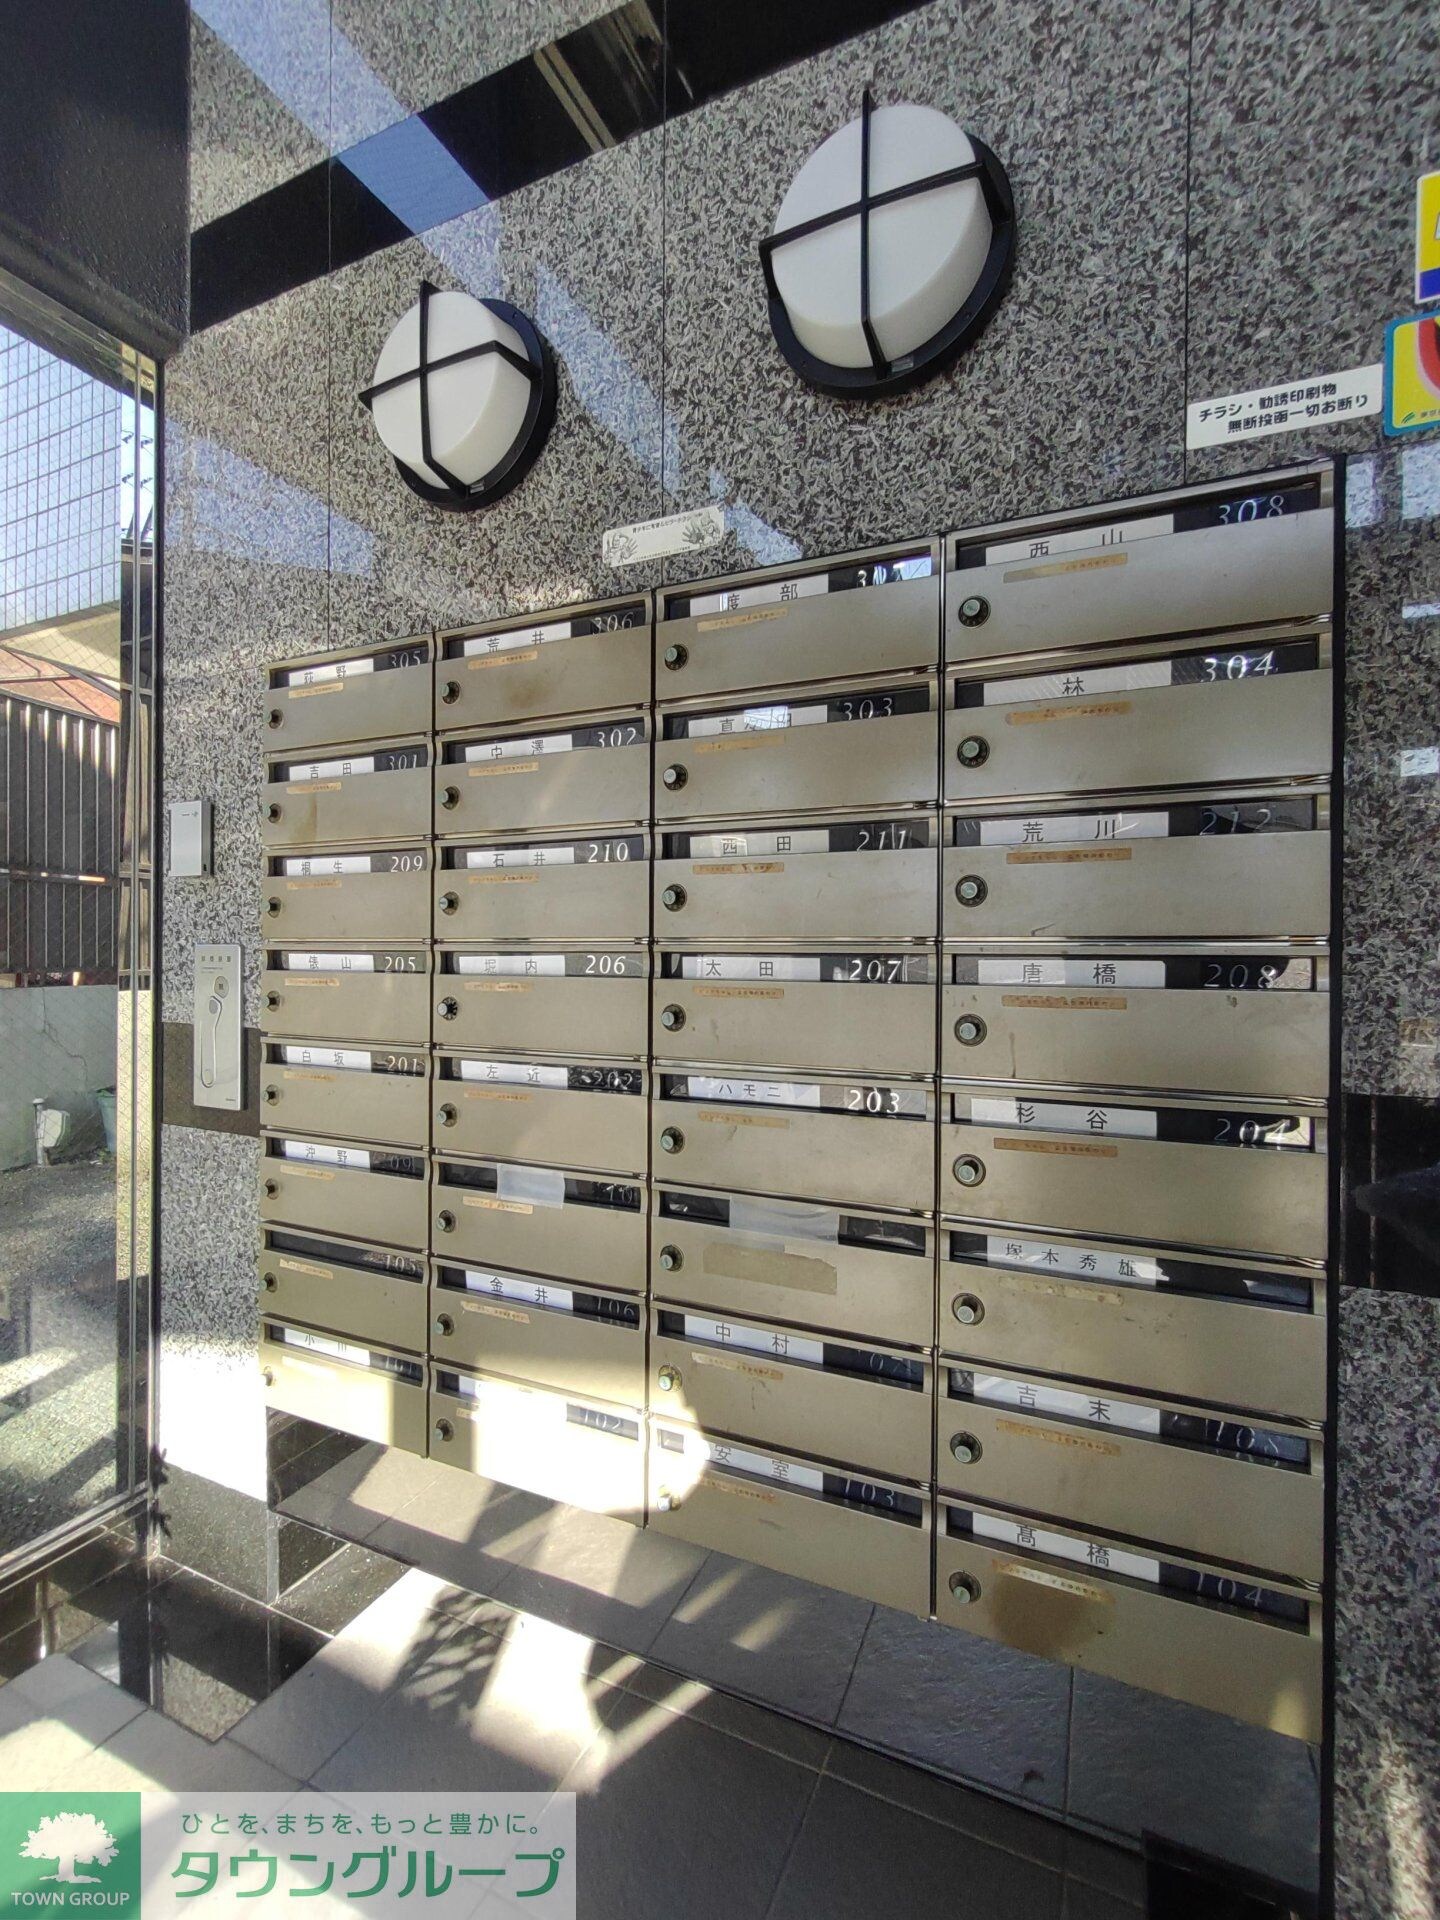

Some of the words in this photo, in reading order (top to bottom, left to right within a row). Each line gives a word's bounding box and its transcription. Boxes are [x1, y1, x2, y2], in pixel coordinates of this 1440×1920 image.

[1199, 383, 1337, 422] チラシ・勧誘印刷物
[1227, 394, 1368, 434] 無断投函一切お断り
[1218, 495, 1284, 525] 308
[592, 611, 633, 634] 306
[486, 630, 545, 653] 荒井
[391, 650, 421, 668] 305
[1201, 650, 1275, 683] 304
[1062, 677, 1085, 696] 林
[842, 698, 892, 720] 303
[597, 727, 637, 748] 302
[309, 762, 352, 779] 吉田
[388, 754, 418, 771] 301
[1022, 819, 1116, 843] 荒川
[1200, 809, 1272, 836] 212
[588, 842, 629, 863] 210
[721, 836, 791, 855] 西田
[390, 855, 424, 873] 209
[492, 851, 547, 868] 石井
[384, 955, 416, 972] 205
[485, 958, 538, 975] 堀内
[585, 955, 626, 974] 206
[706, 960, 773, 977] 太田
[850, 959, 901, 981] 207
[1022, 963, 1116, 984] 唐橋
[1204, 963, 1278, 989] 208
[301, 1049, 345, 1066] 白坂
[387, 1055, 417, 1072] 201
[485, 1065, 541, 1084] 左近
[719, 1084, 781, 1097] ハモニ
[848, 1089, 900, 1113] 203
[1016, 1103, 1108, 1131] 杉谷
[1214, 1119, 1289, 1144] 204
[385, 1255, 416, 1274] 105
[489, 1276, 548, 1303] 金井
[597, 1297, 634, 1317] 106
[304, 1331, 347, 1353] 小川
[715, 1323, 789, 1354] 中村
[584, 1410, 622, 1430] 102
[715, 1445, 789, 1480] 安室
[845, 1479, 894, 1506] 103
[1198, 1572, 1263, 1606] 104
